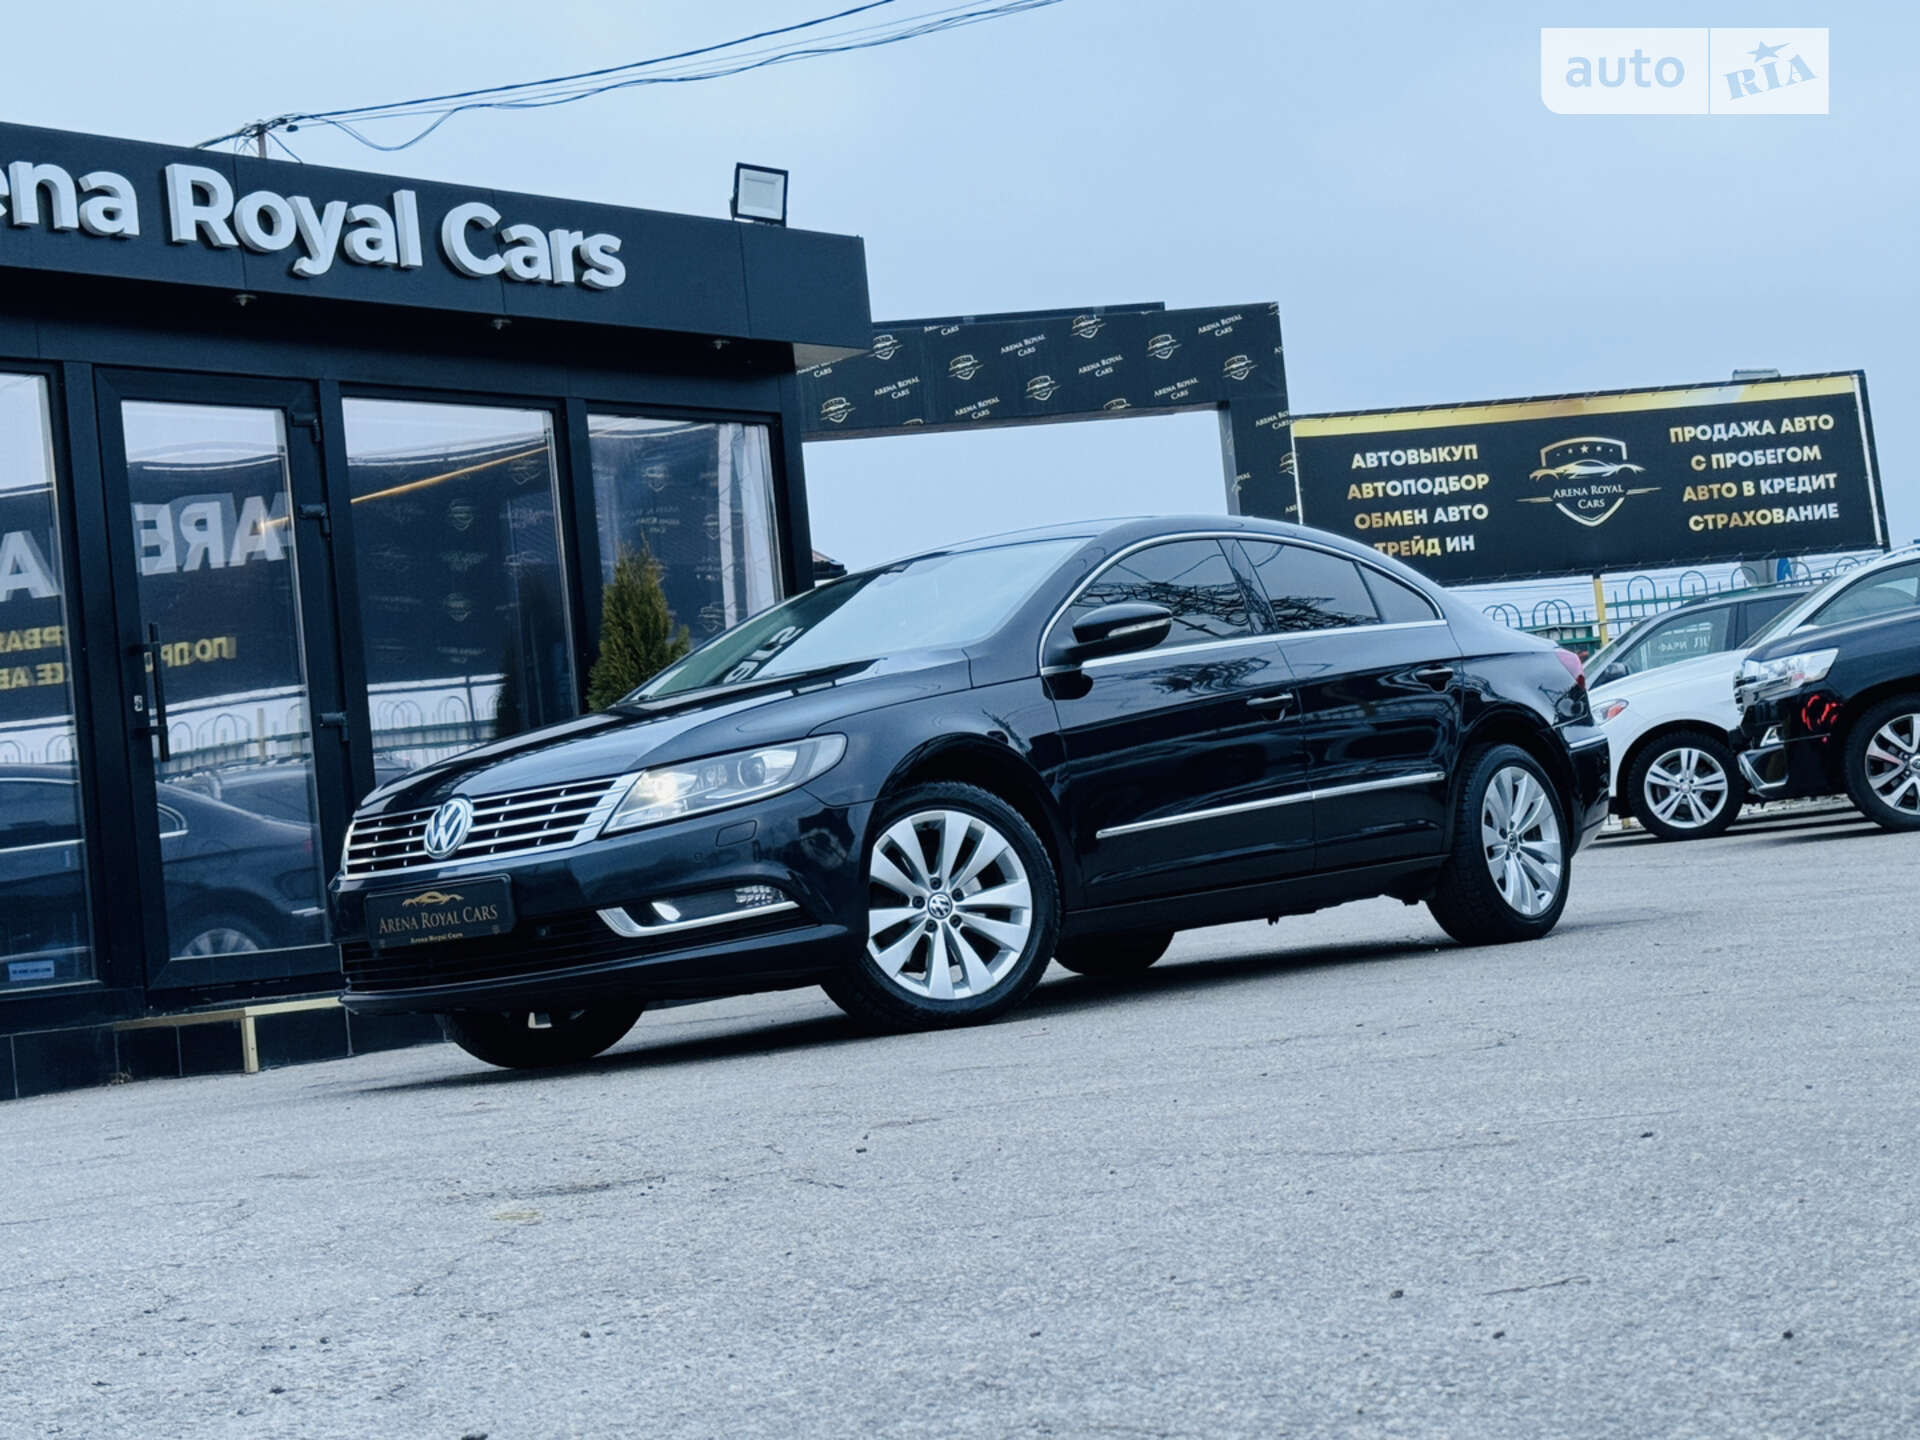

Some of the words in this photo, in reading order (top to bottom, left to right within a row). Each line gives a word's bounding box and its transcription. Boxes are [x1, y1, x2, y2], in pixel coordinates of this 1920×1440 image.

[0, 160, 140, 239] na
[165, 163, 423, 278] Royal
[441, 202, 627, 290] Cars
[1669, 420, 1776, 443] ПРОДАЖА
[1780, 414, 1834, 434] АВТО
[1351, 444, 1478, 469] АВТОВЫКУП
[1691, 455, 1707, 471] С
[1711, 445, 1822, 469] ПРОБЕГОМ
[1347, 473, 1490, 500] АВТОПОДБОР
[1553, 487, 1588, 499] ARENA
[1590, 484, 1624, 496] ROYAL
[1683, 482, 1738, 502] АВТО
[1742, 480, 1755, 496] В
[1760, 473, 1837, 494] КРЕДИТ
[1354, 508, 1428, 530] ОБМЕН
[1433, 504, 1489, 524] АВТО
[1577, 498, 1606, 510] CARS
[1689, 503, 1839, 531] СТРАХОВАНИЕ
[1446, 534, 1475, 552] ИН
[379, 917, 418, 934] ARENA
[421, 912, 461, 929] ROYAL
[463, 904, 498, 922] CARS
